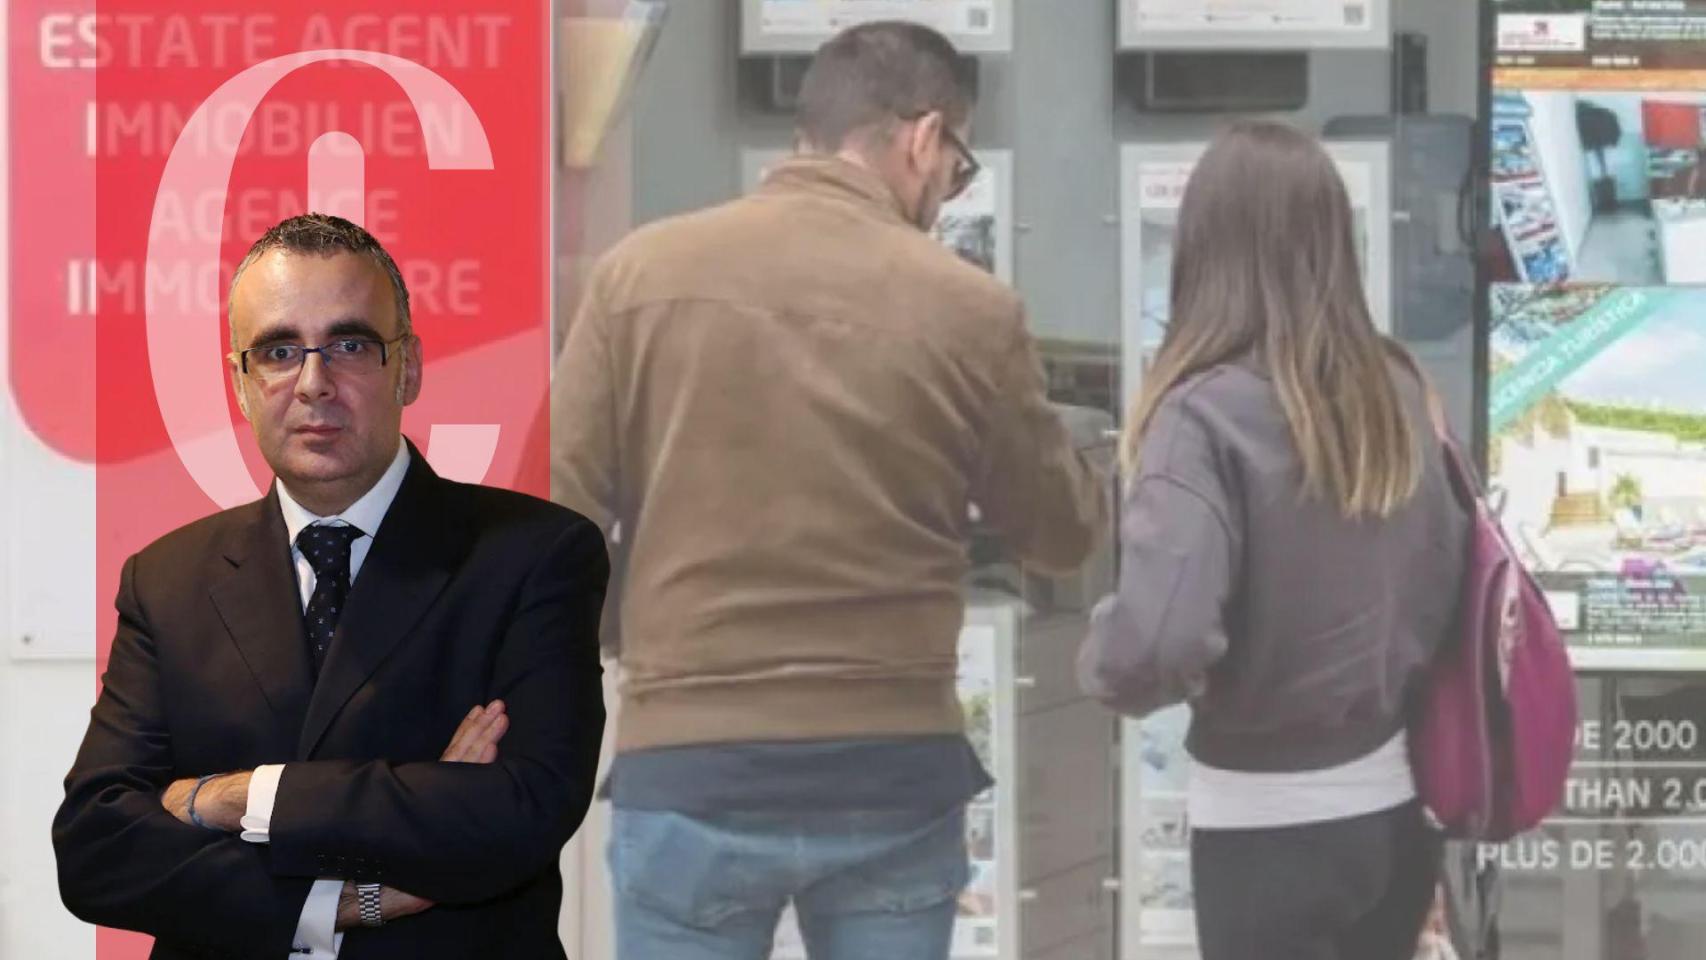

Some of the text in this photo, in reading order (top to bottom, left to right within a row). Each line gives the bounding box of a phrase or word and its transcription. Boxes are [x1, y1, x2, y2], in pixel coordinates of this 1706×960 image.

[39, 14, 512, 69] ESTATE AGENT
[86, 102, 466, 158] IMMOBILIEN
[1574, 719, 1697, 750] E 2000
[1565, 777, 1651, 809] THAN
[1475, 839, 1560, 871] PLUS
[1571, 839, 1614, 870] DE
